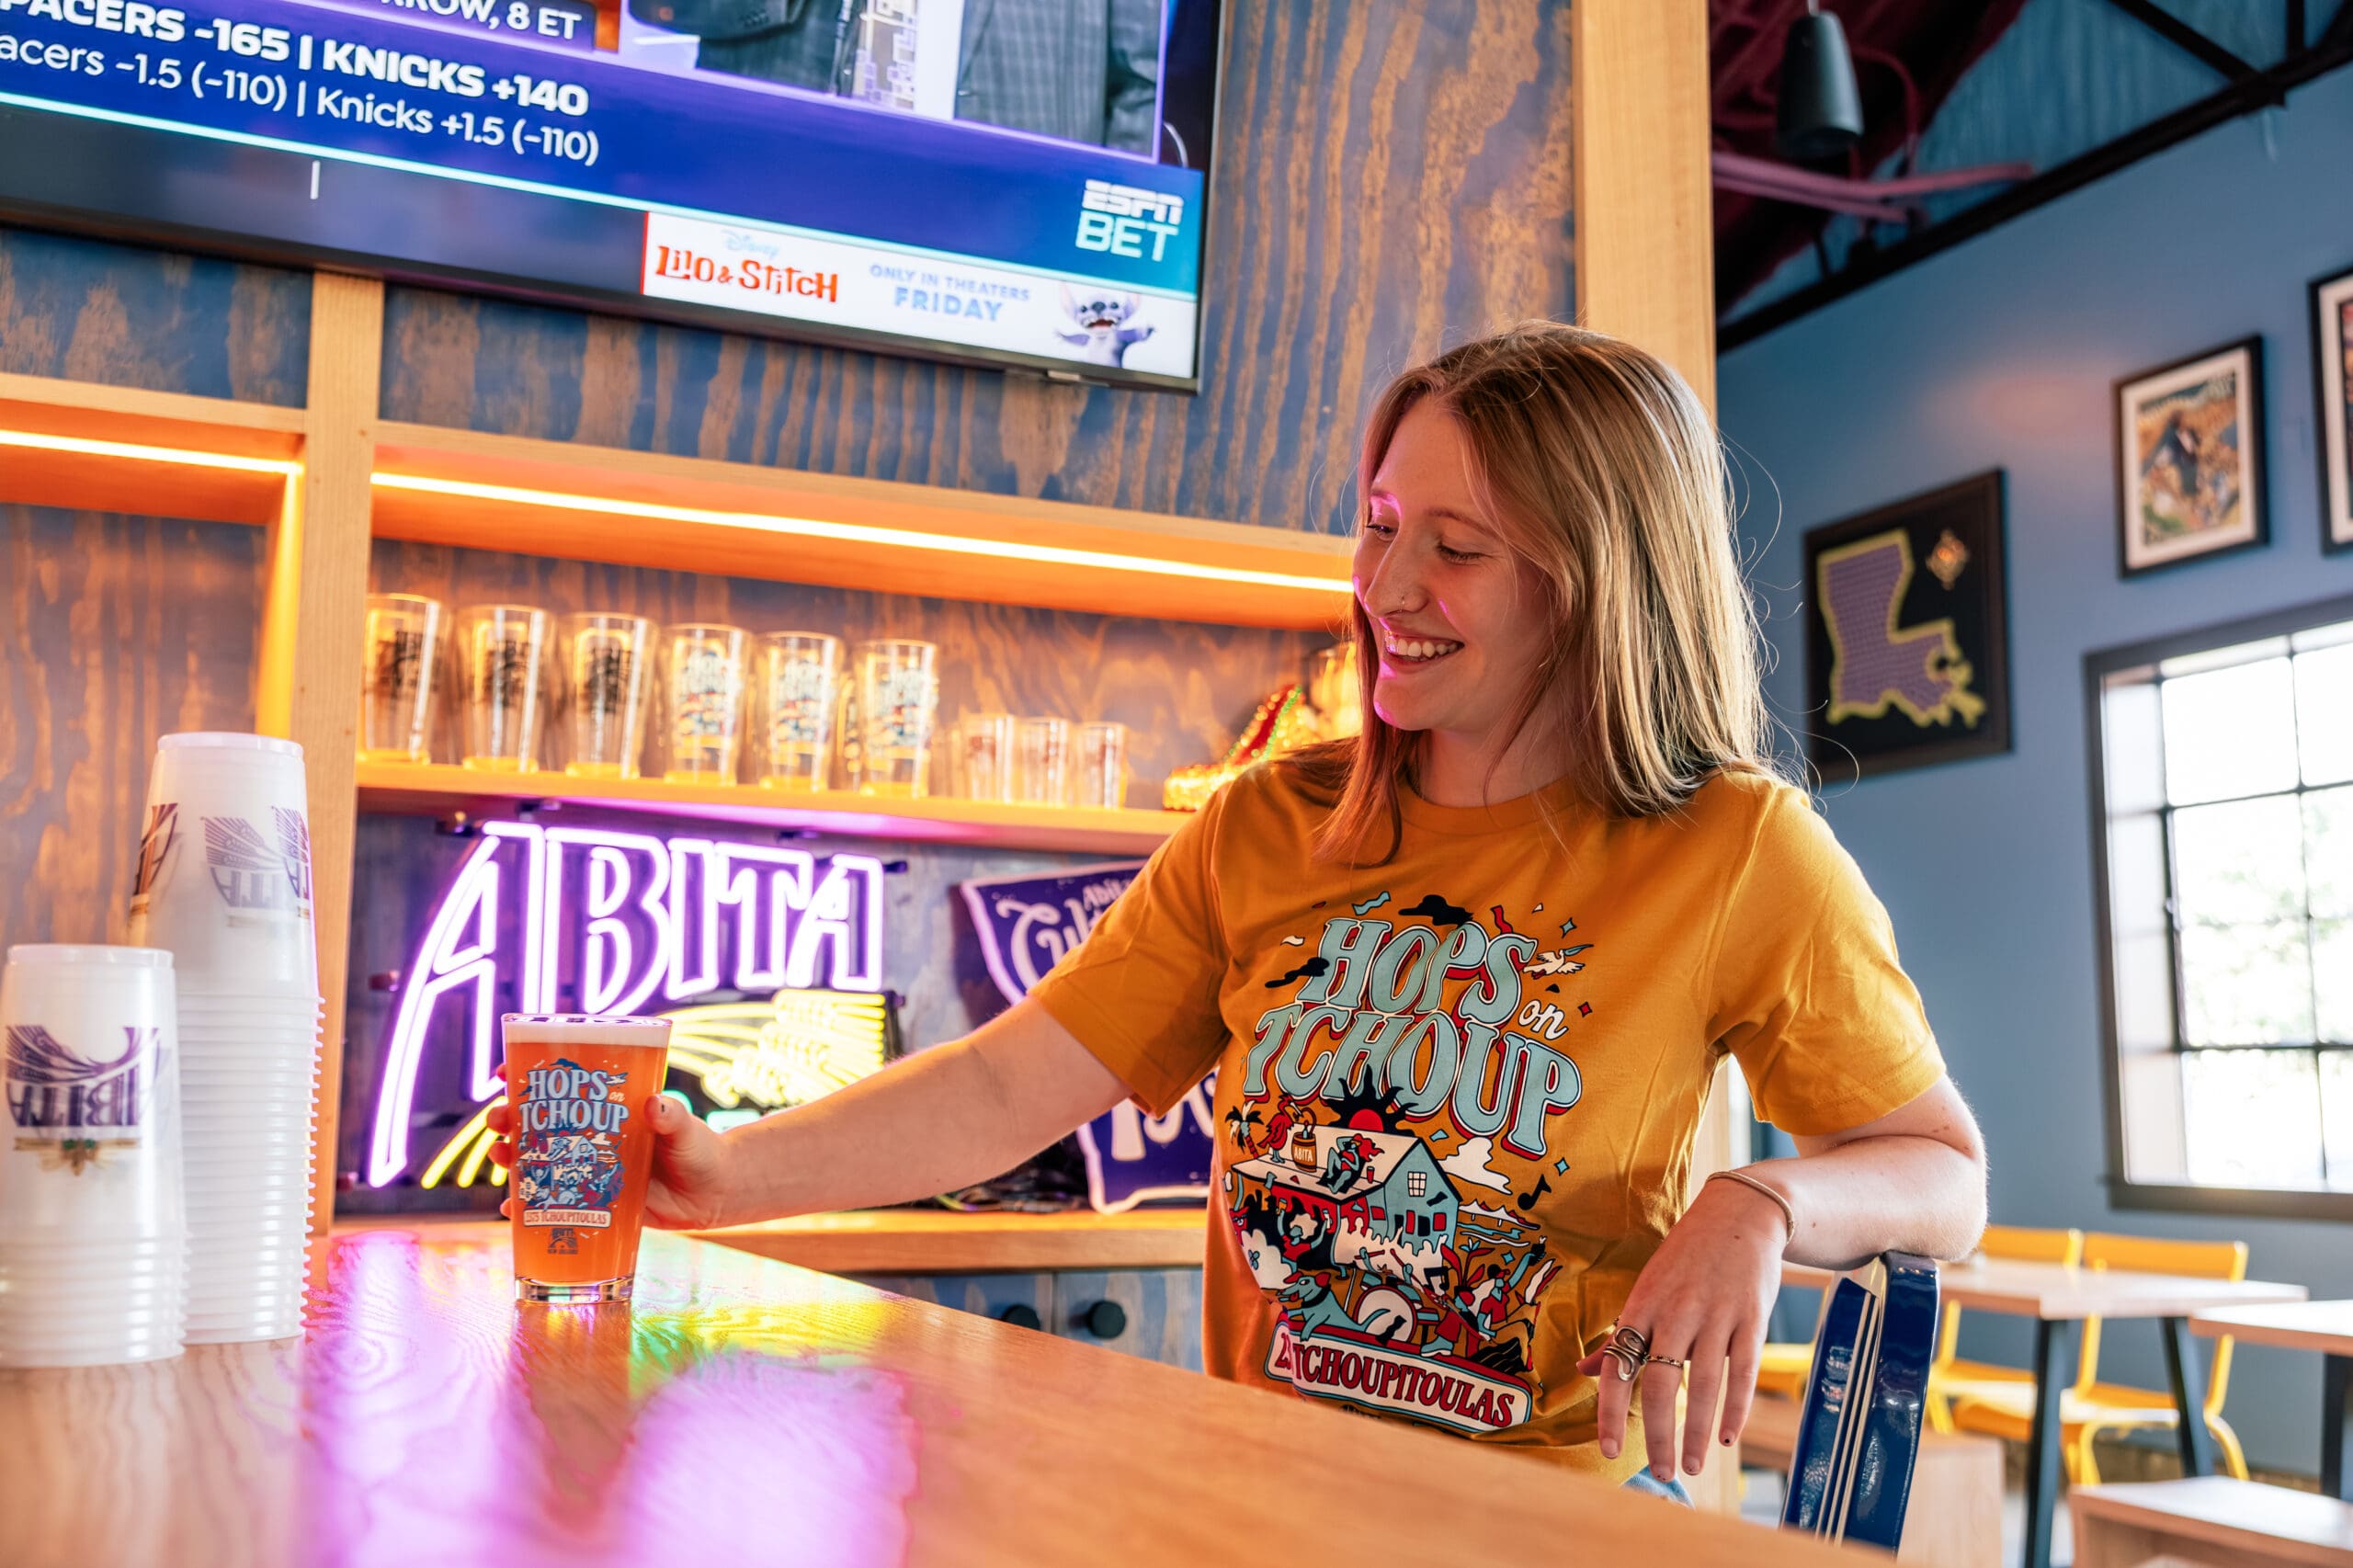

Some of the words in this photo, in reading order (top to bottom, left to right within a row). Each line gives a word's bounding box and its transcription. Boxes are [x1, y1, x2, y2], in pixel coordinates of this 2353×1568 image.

[506, 2, 530, 30] 8
[538, 7, 582, 40] ET
[195, 17, 290, 62] -165
[323, 39, 485, 97] KNICKS
[492, 74, 589, 116] +140
[116, 53, 182, 89] -1.5
[191, 61, 287, 111] (-110)
[317, 86, 433, 134] Knicks
[440, 111, 505, 146] +1.5
[512, 118, 599, 166] (-110)
[1082, 178, 1184, 225] ESPN
[1075, 210, 1179, 262] BET
[869, 264, 915, 282] ONLY
[921, 273, 938, 287] IN
[946, 276, 1030, 302] THEATERS
[894, 286, 1003, 322] FRIDAY
[1295, 917, 1539, 1024] HOPS
[1518, 998, 1569, 1040] on
[369, 820, 884, 1188] ABITA
[528, 1069, 608, 1101] HOPS
[608, 1091, 625, 1102] on
[1243, 1004, 1583, 1160] TCHOUP
[519, 1100, 630, 1133] TCHOUP
[1294, 1146, 1313, 1163] ABITA
[1292, 1343, 1515, 1427] TCHOUPITOULAS
